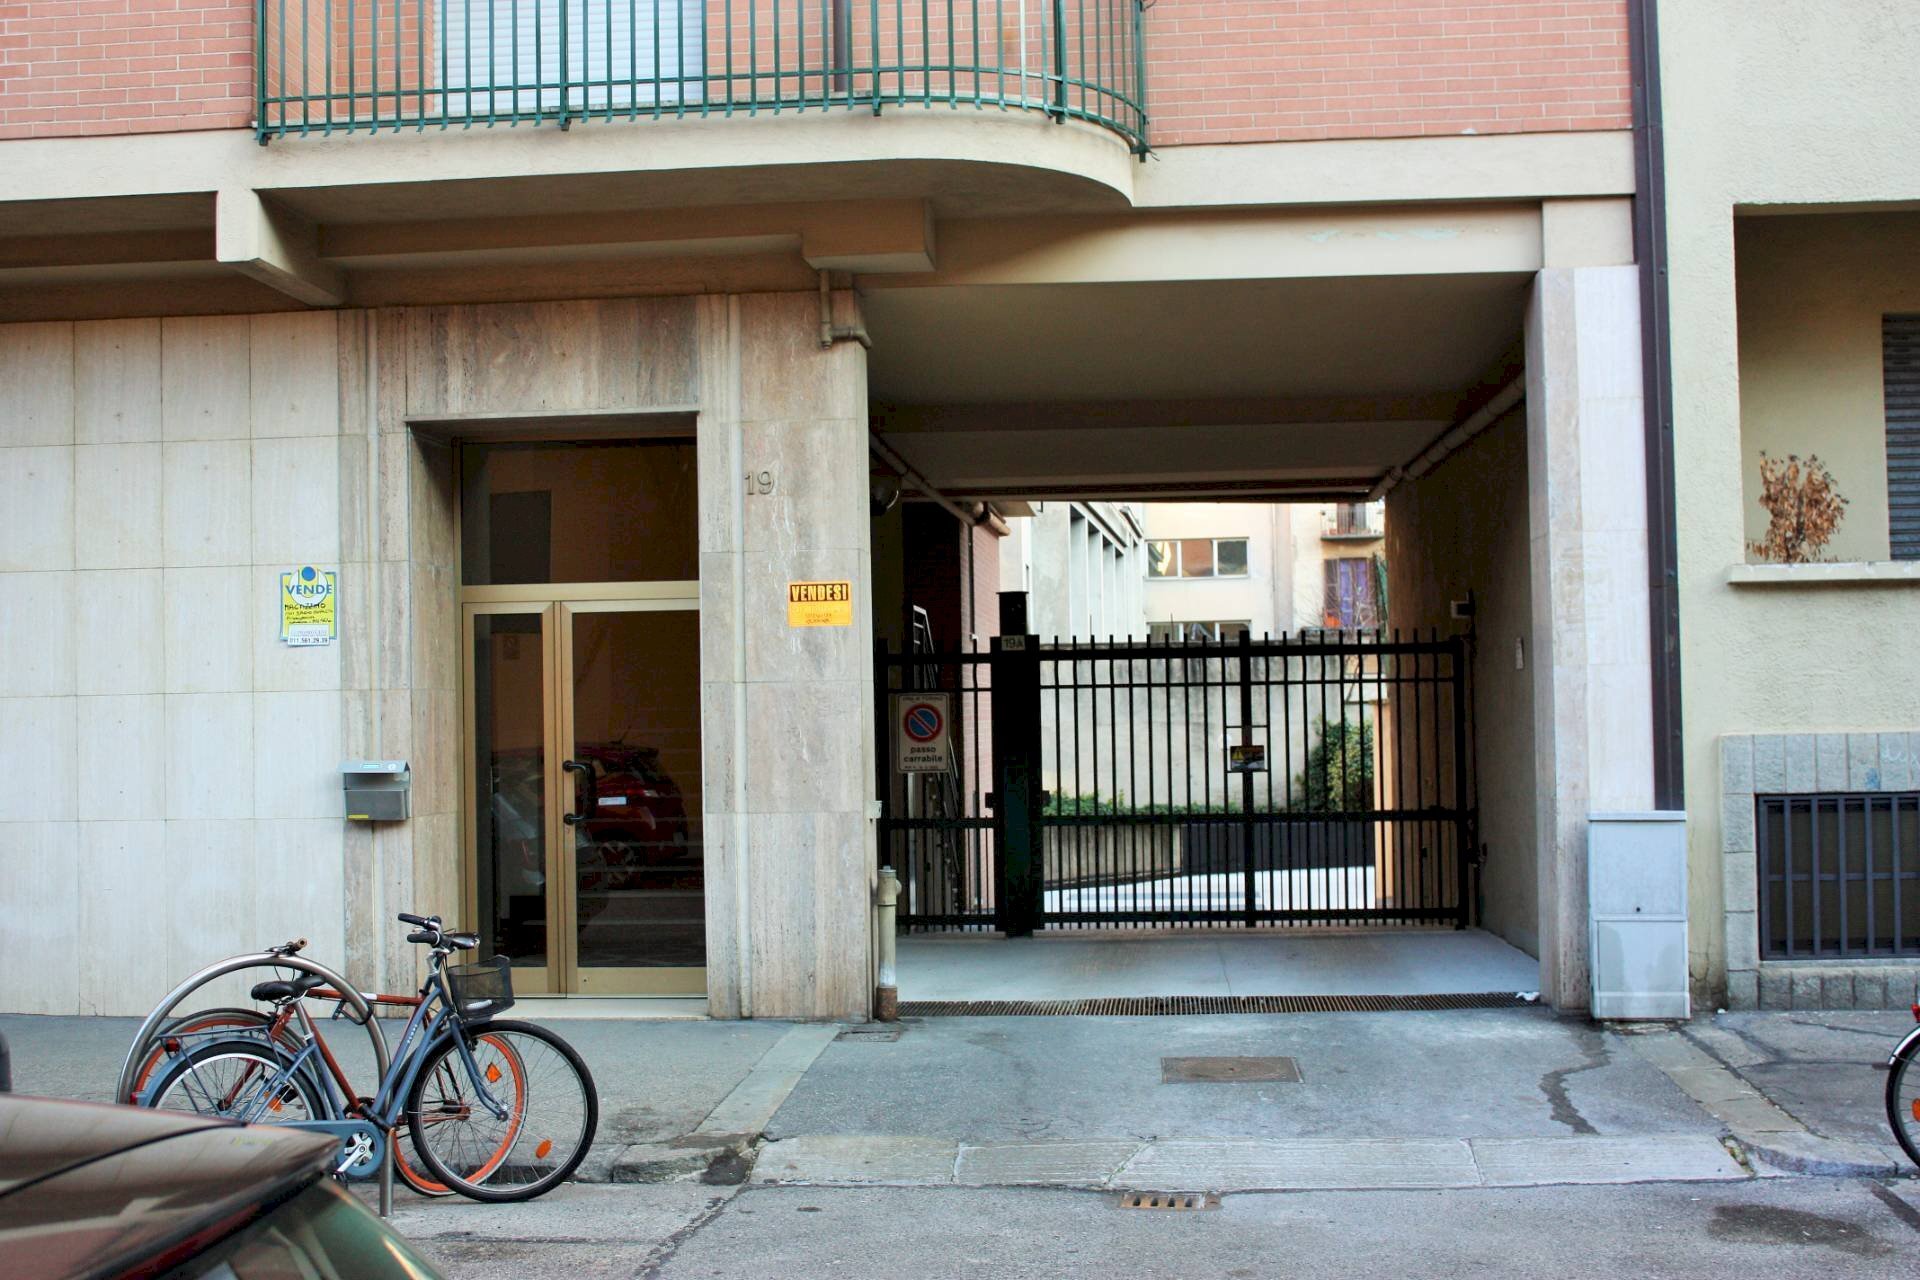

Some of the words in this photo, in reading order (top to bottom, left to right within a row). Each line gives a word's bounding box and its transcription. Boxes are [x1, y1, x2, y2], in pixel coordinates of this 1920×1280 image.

[744, 471, 774, 496] 19
[285, 584, 332, 595] VENDE
[791, 584, 847, 601] VENDESI
[910, 746, 937, 754] passo
[903, 754, 943, 763] carrabile
